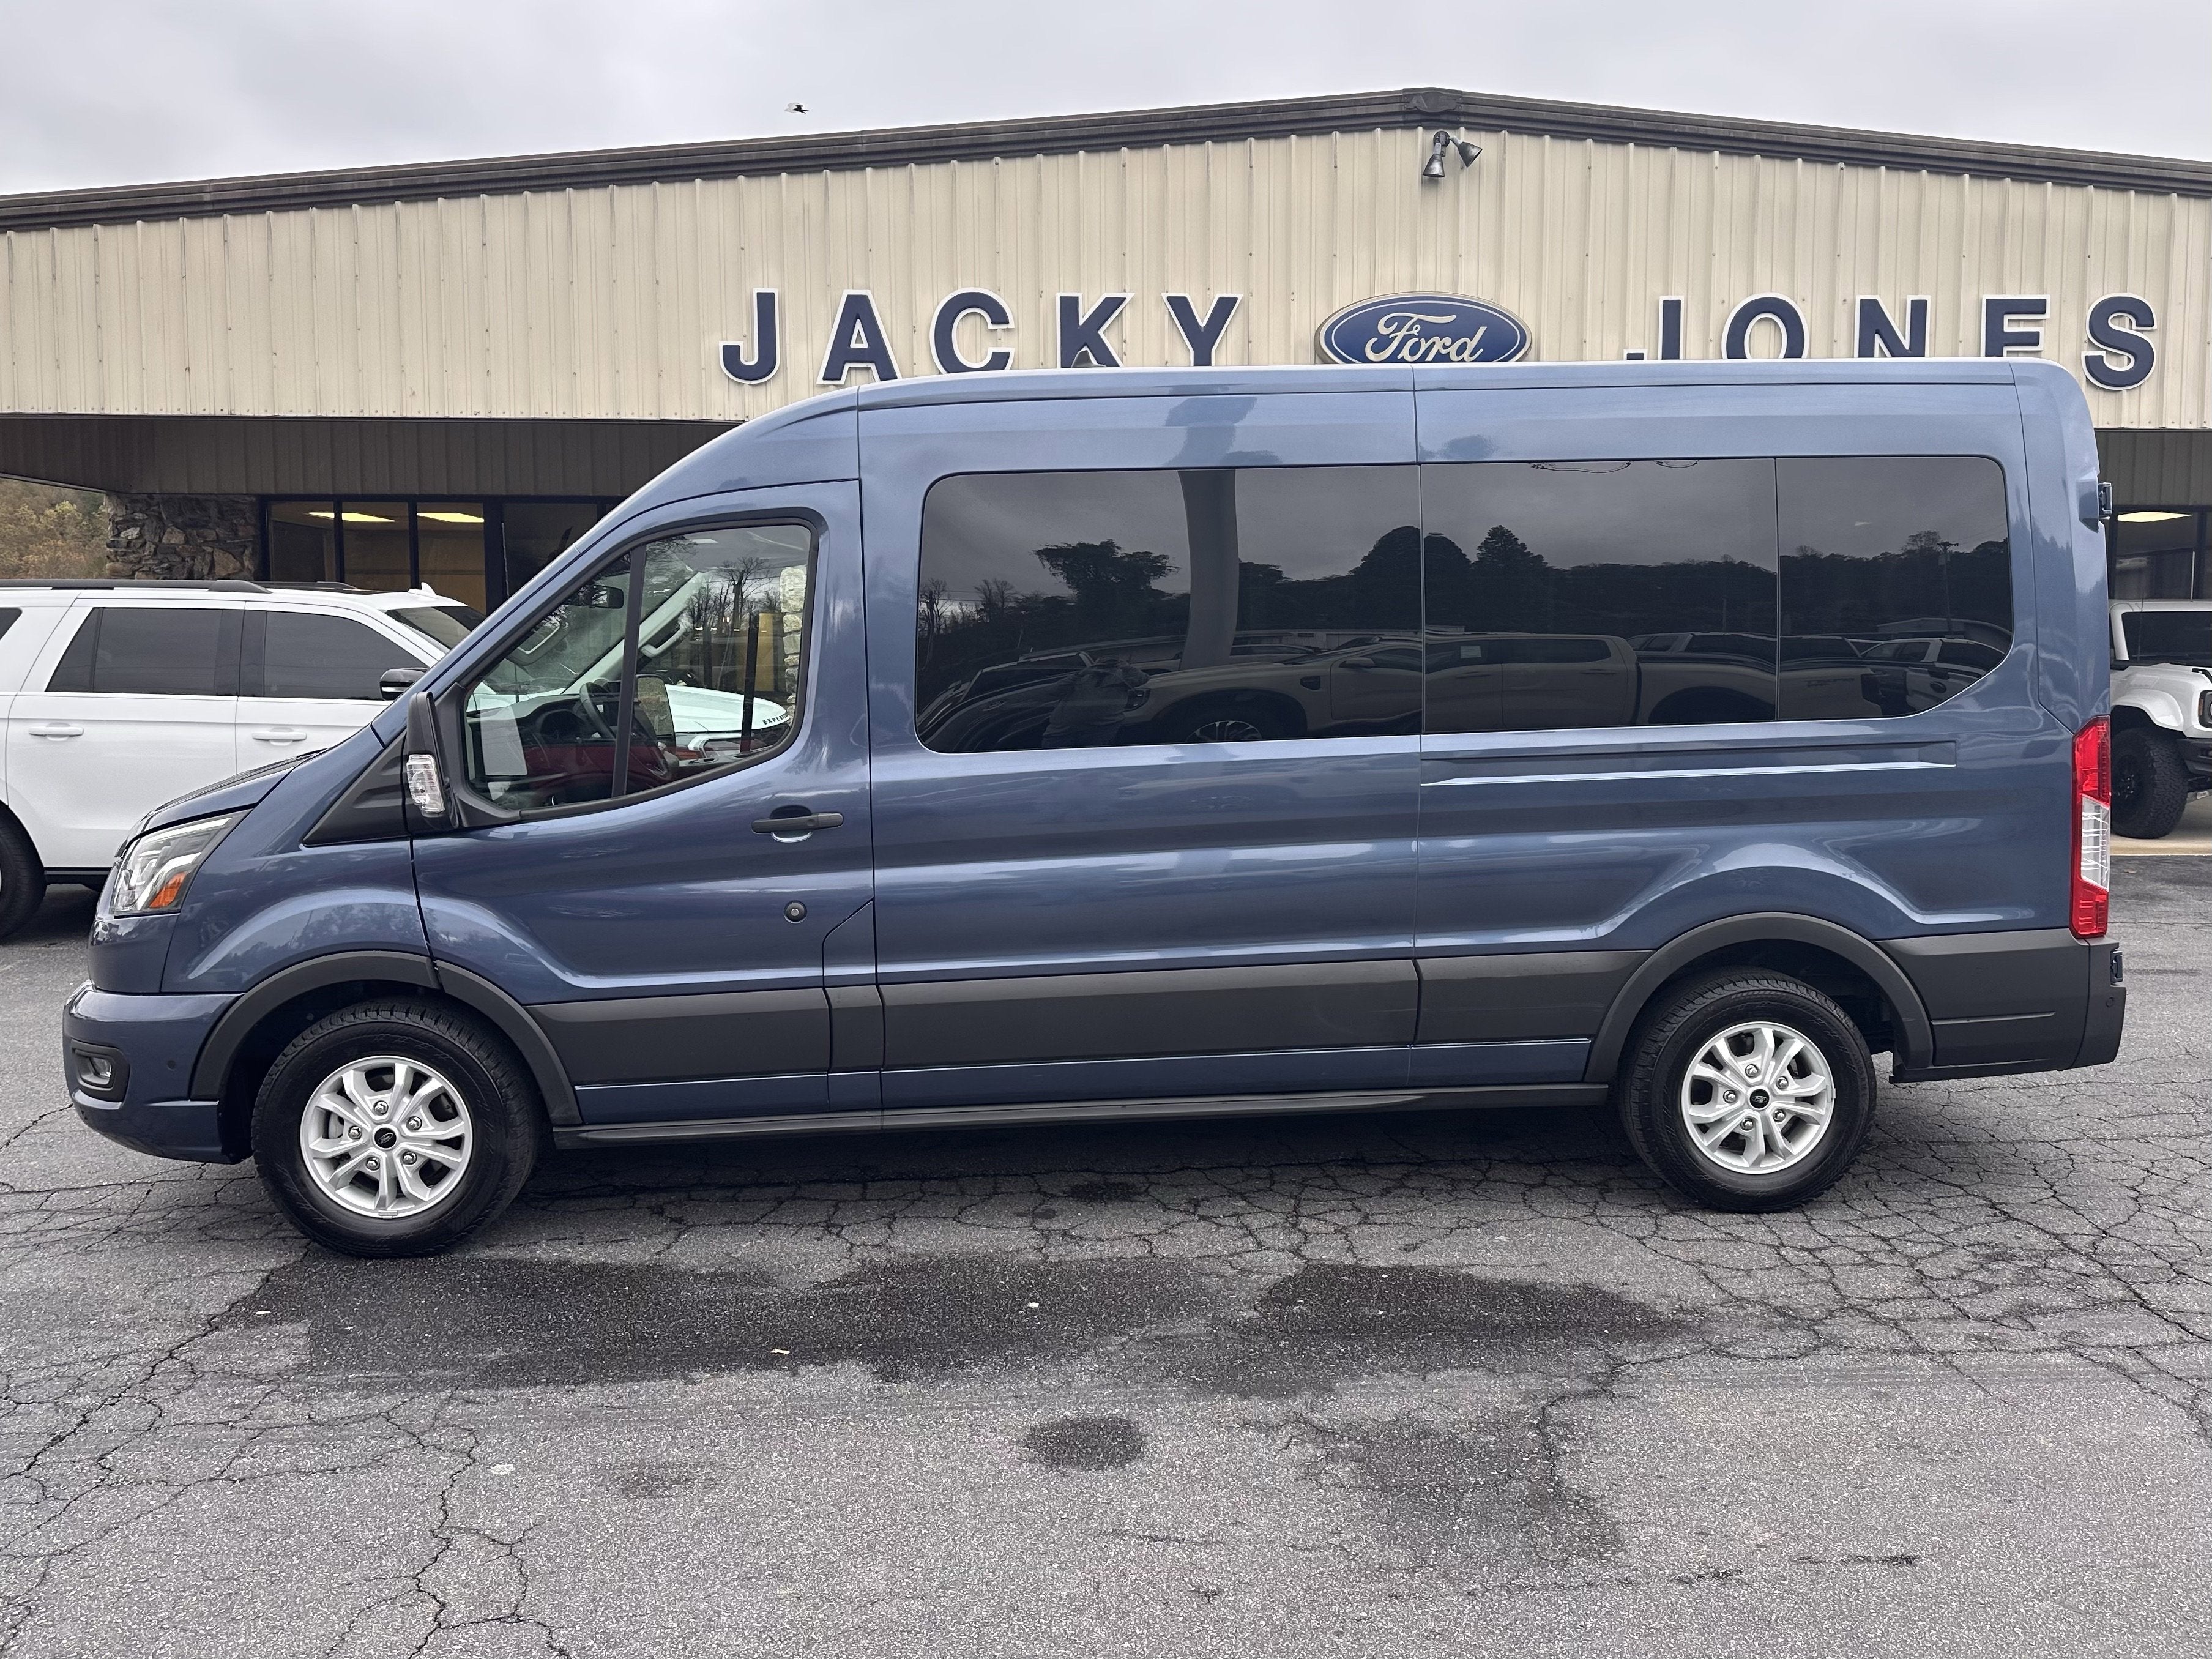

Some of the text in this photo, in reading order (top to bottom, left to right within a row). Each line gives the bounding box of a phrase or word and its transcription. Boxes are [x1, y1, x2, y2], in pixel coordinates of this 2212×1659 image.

[719, 288, 2158, 390] JACKY JONES
[1365, 312, 1488, 362] Ford
